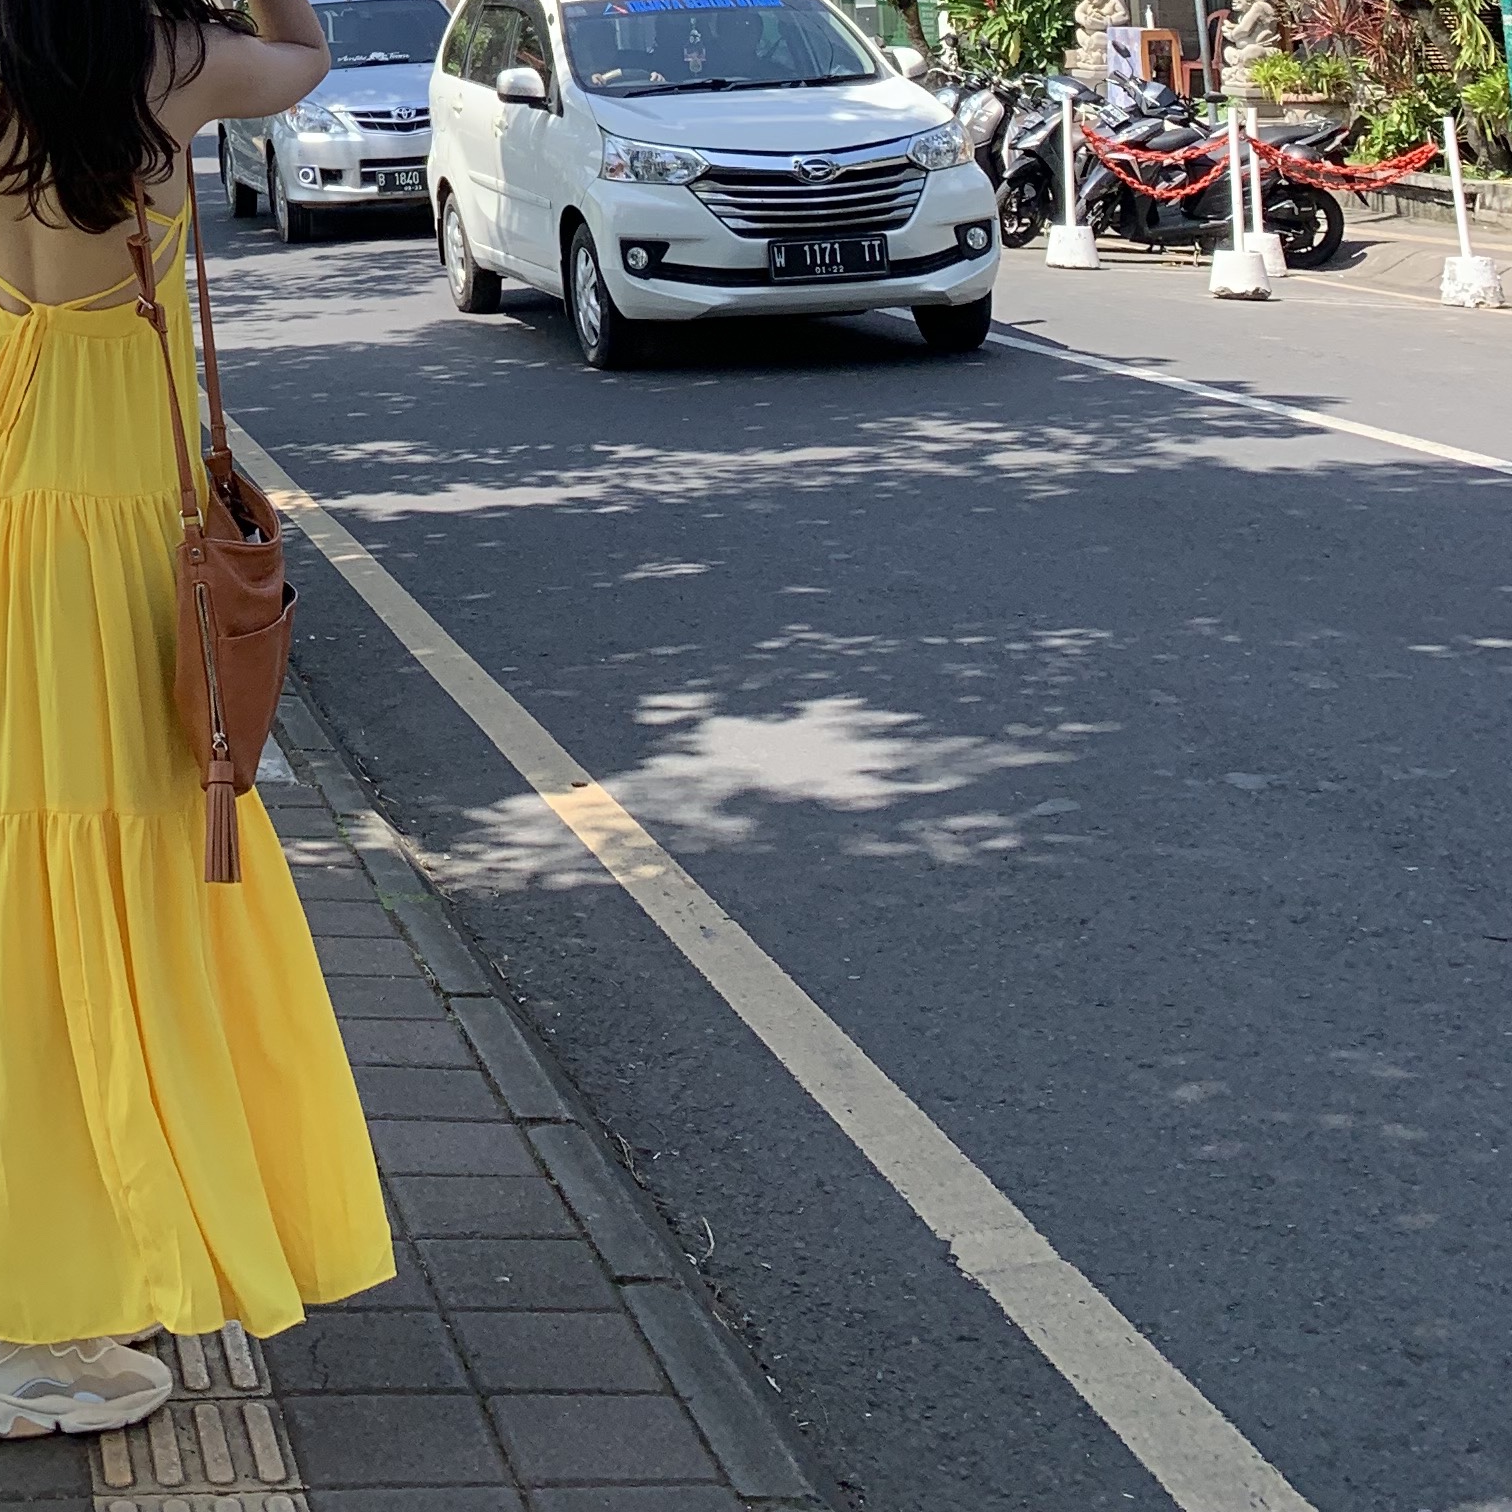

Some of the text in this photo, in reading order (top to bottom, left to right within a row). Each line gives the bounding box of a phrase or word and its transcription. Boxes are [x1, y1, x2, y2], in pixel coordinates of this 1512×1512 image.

[378, 171, 420, 186] B 1840
[774, 240, 881, 268] W 1171 TT
